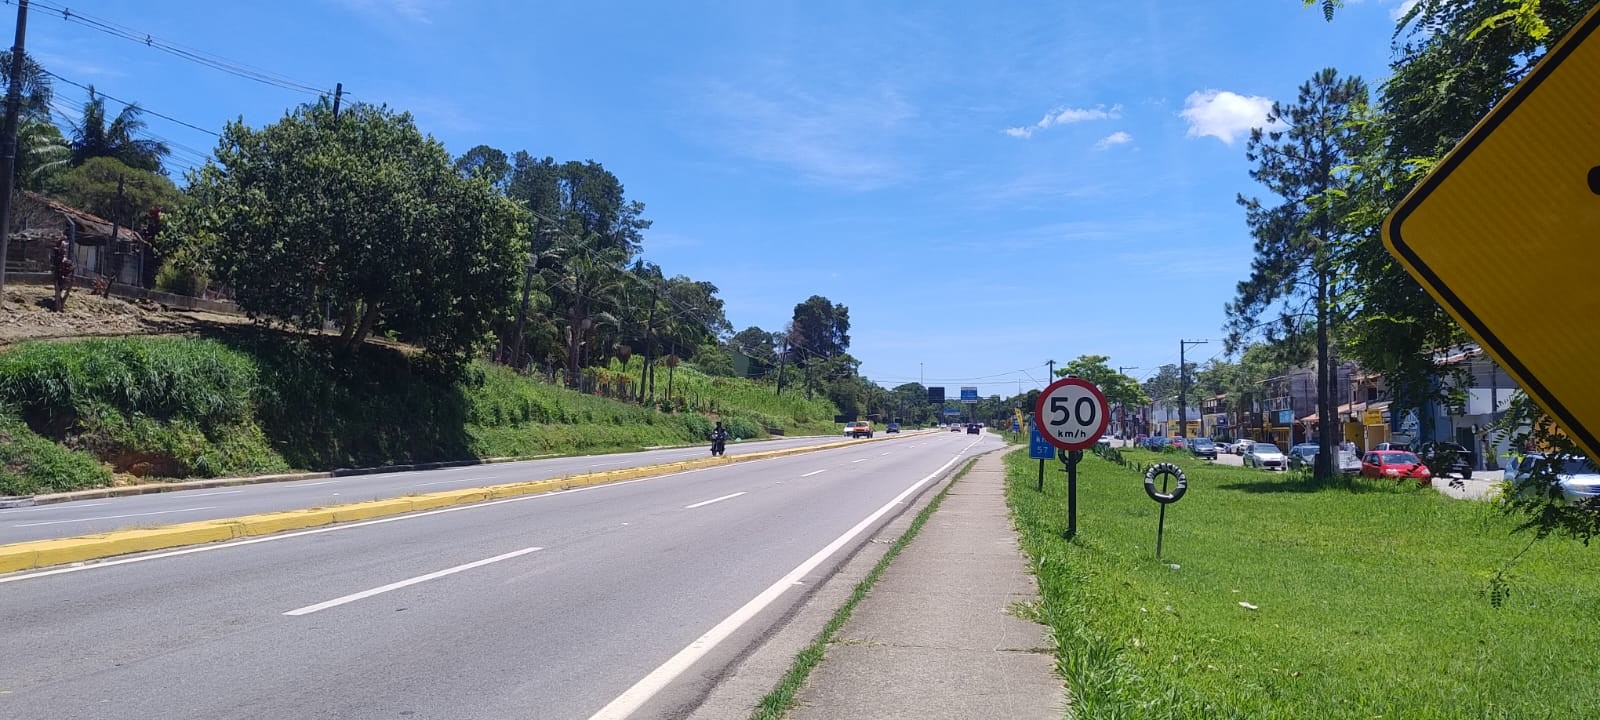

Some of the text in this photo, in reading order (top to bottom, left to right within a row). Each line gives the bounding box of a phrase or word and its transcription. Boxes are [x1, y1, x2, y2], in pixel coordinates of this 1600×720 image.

[1050, 396, 1096, 427] 50
[1058, 428, 1086, 439] km/h
[1037, 446, 1048, 454] 57
[1144, 462, 1187, 489] BORRACHARIA
